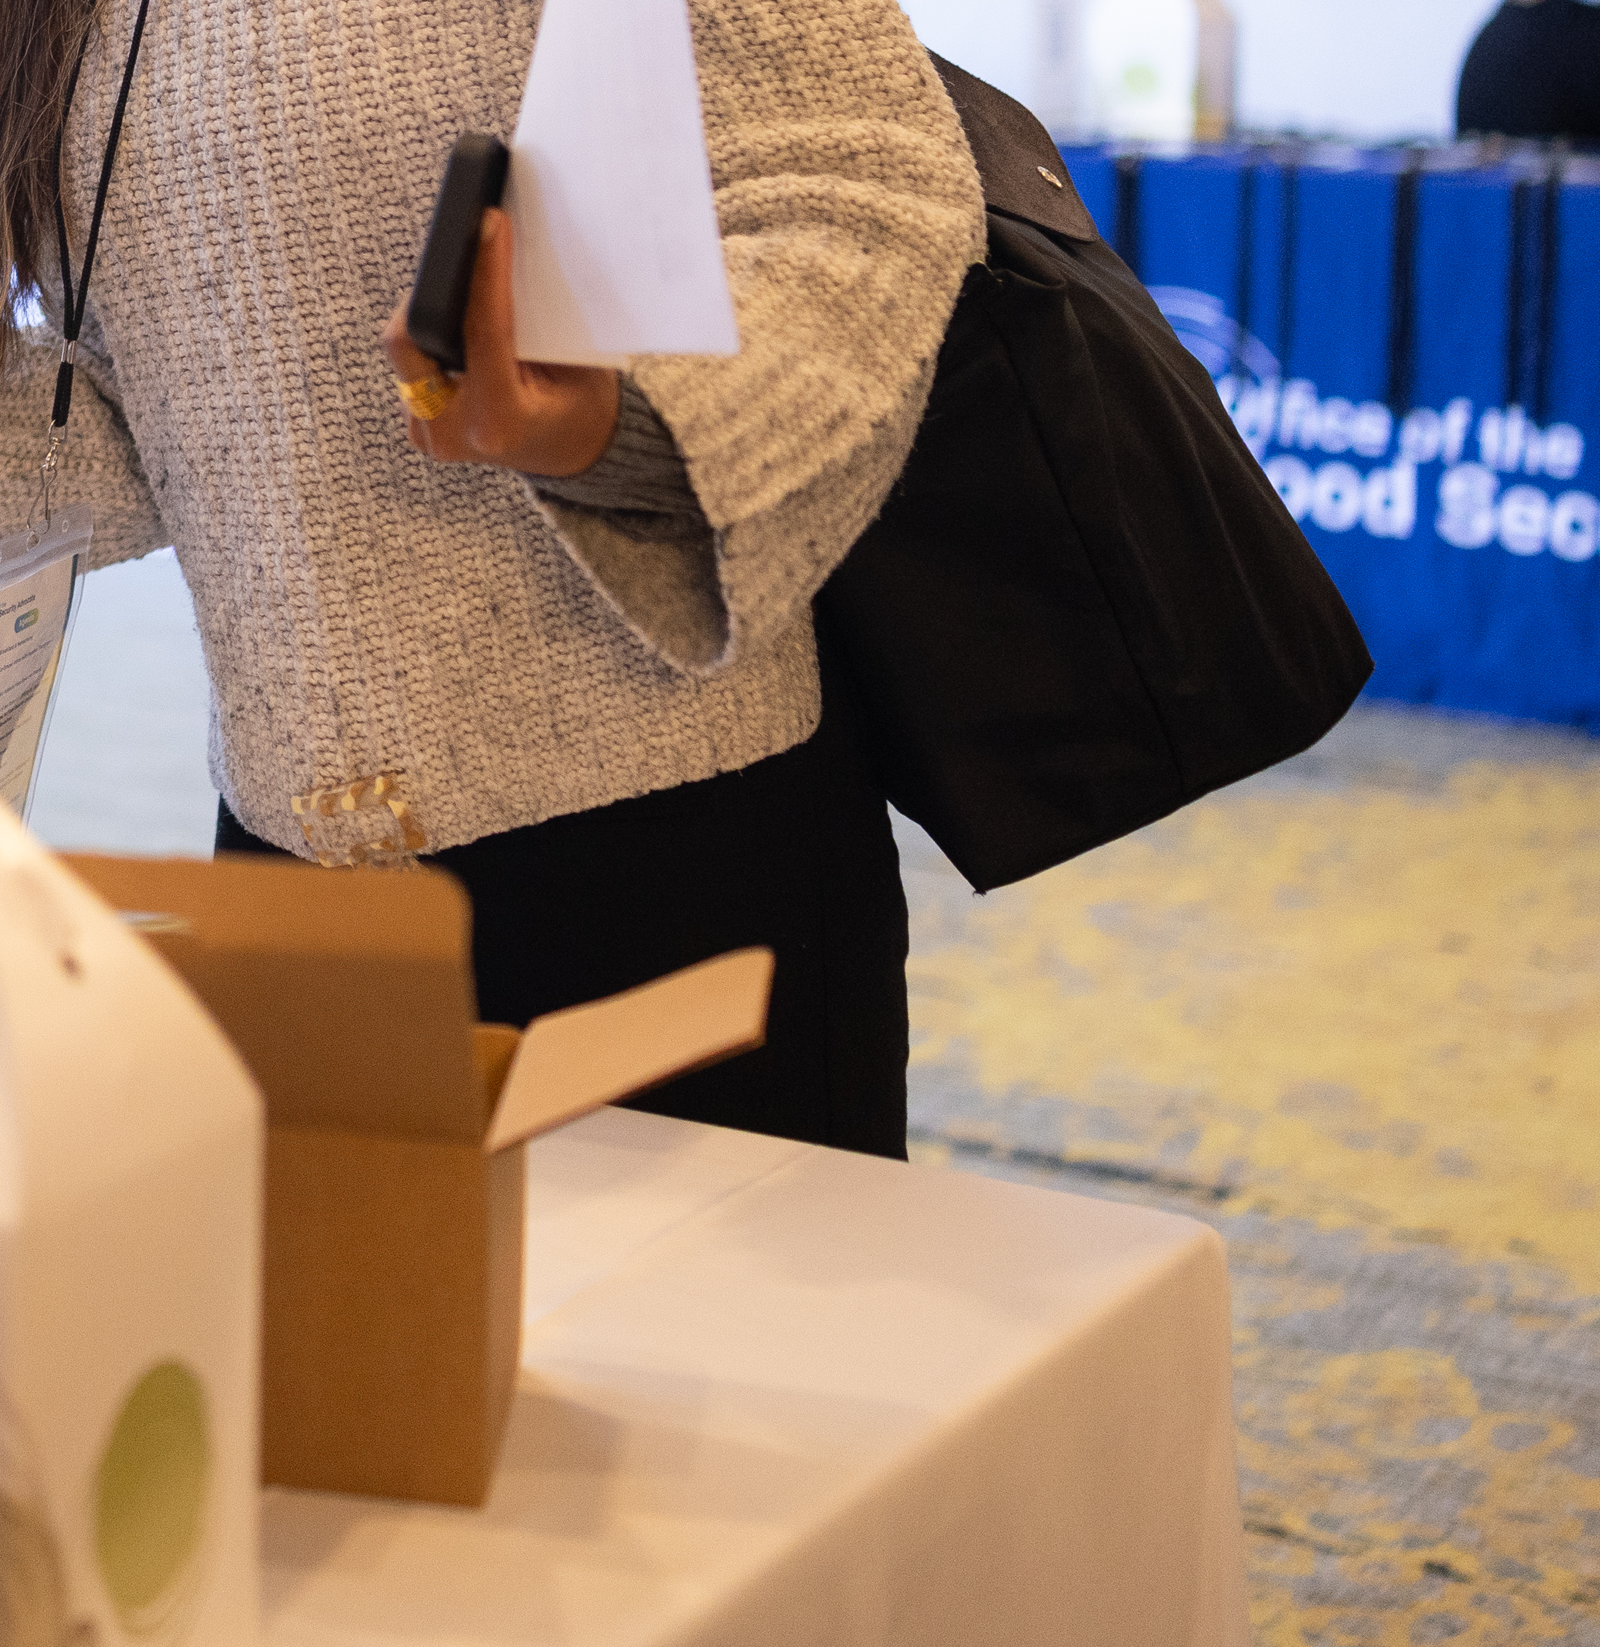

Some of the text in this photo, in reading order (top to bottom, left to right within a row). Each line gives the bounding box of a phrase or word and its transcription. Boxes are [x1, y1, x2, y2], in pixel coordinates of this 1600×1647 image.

[1399, 395, 1474, 466] of
[1476, 404, 1585, 481] the
[1263, 454, 1600, 564] ood Sec
